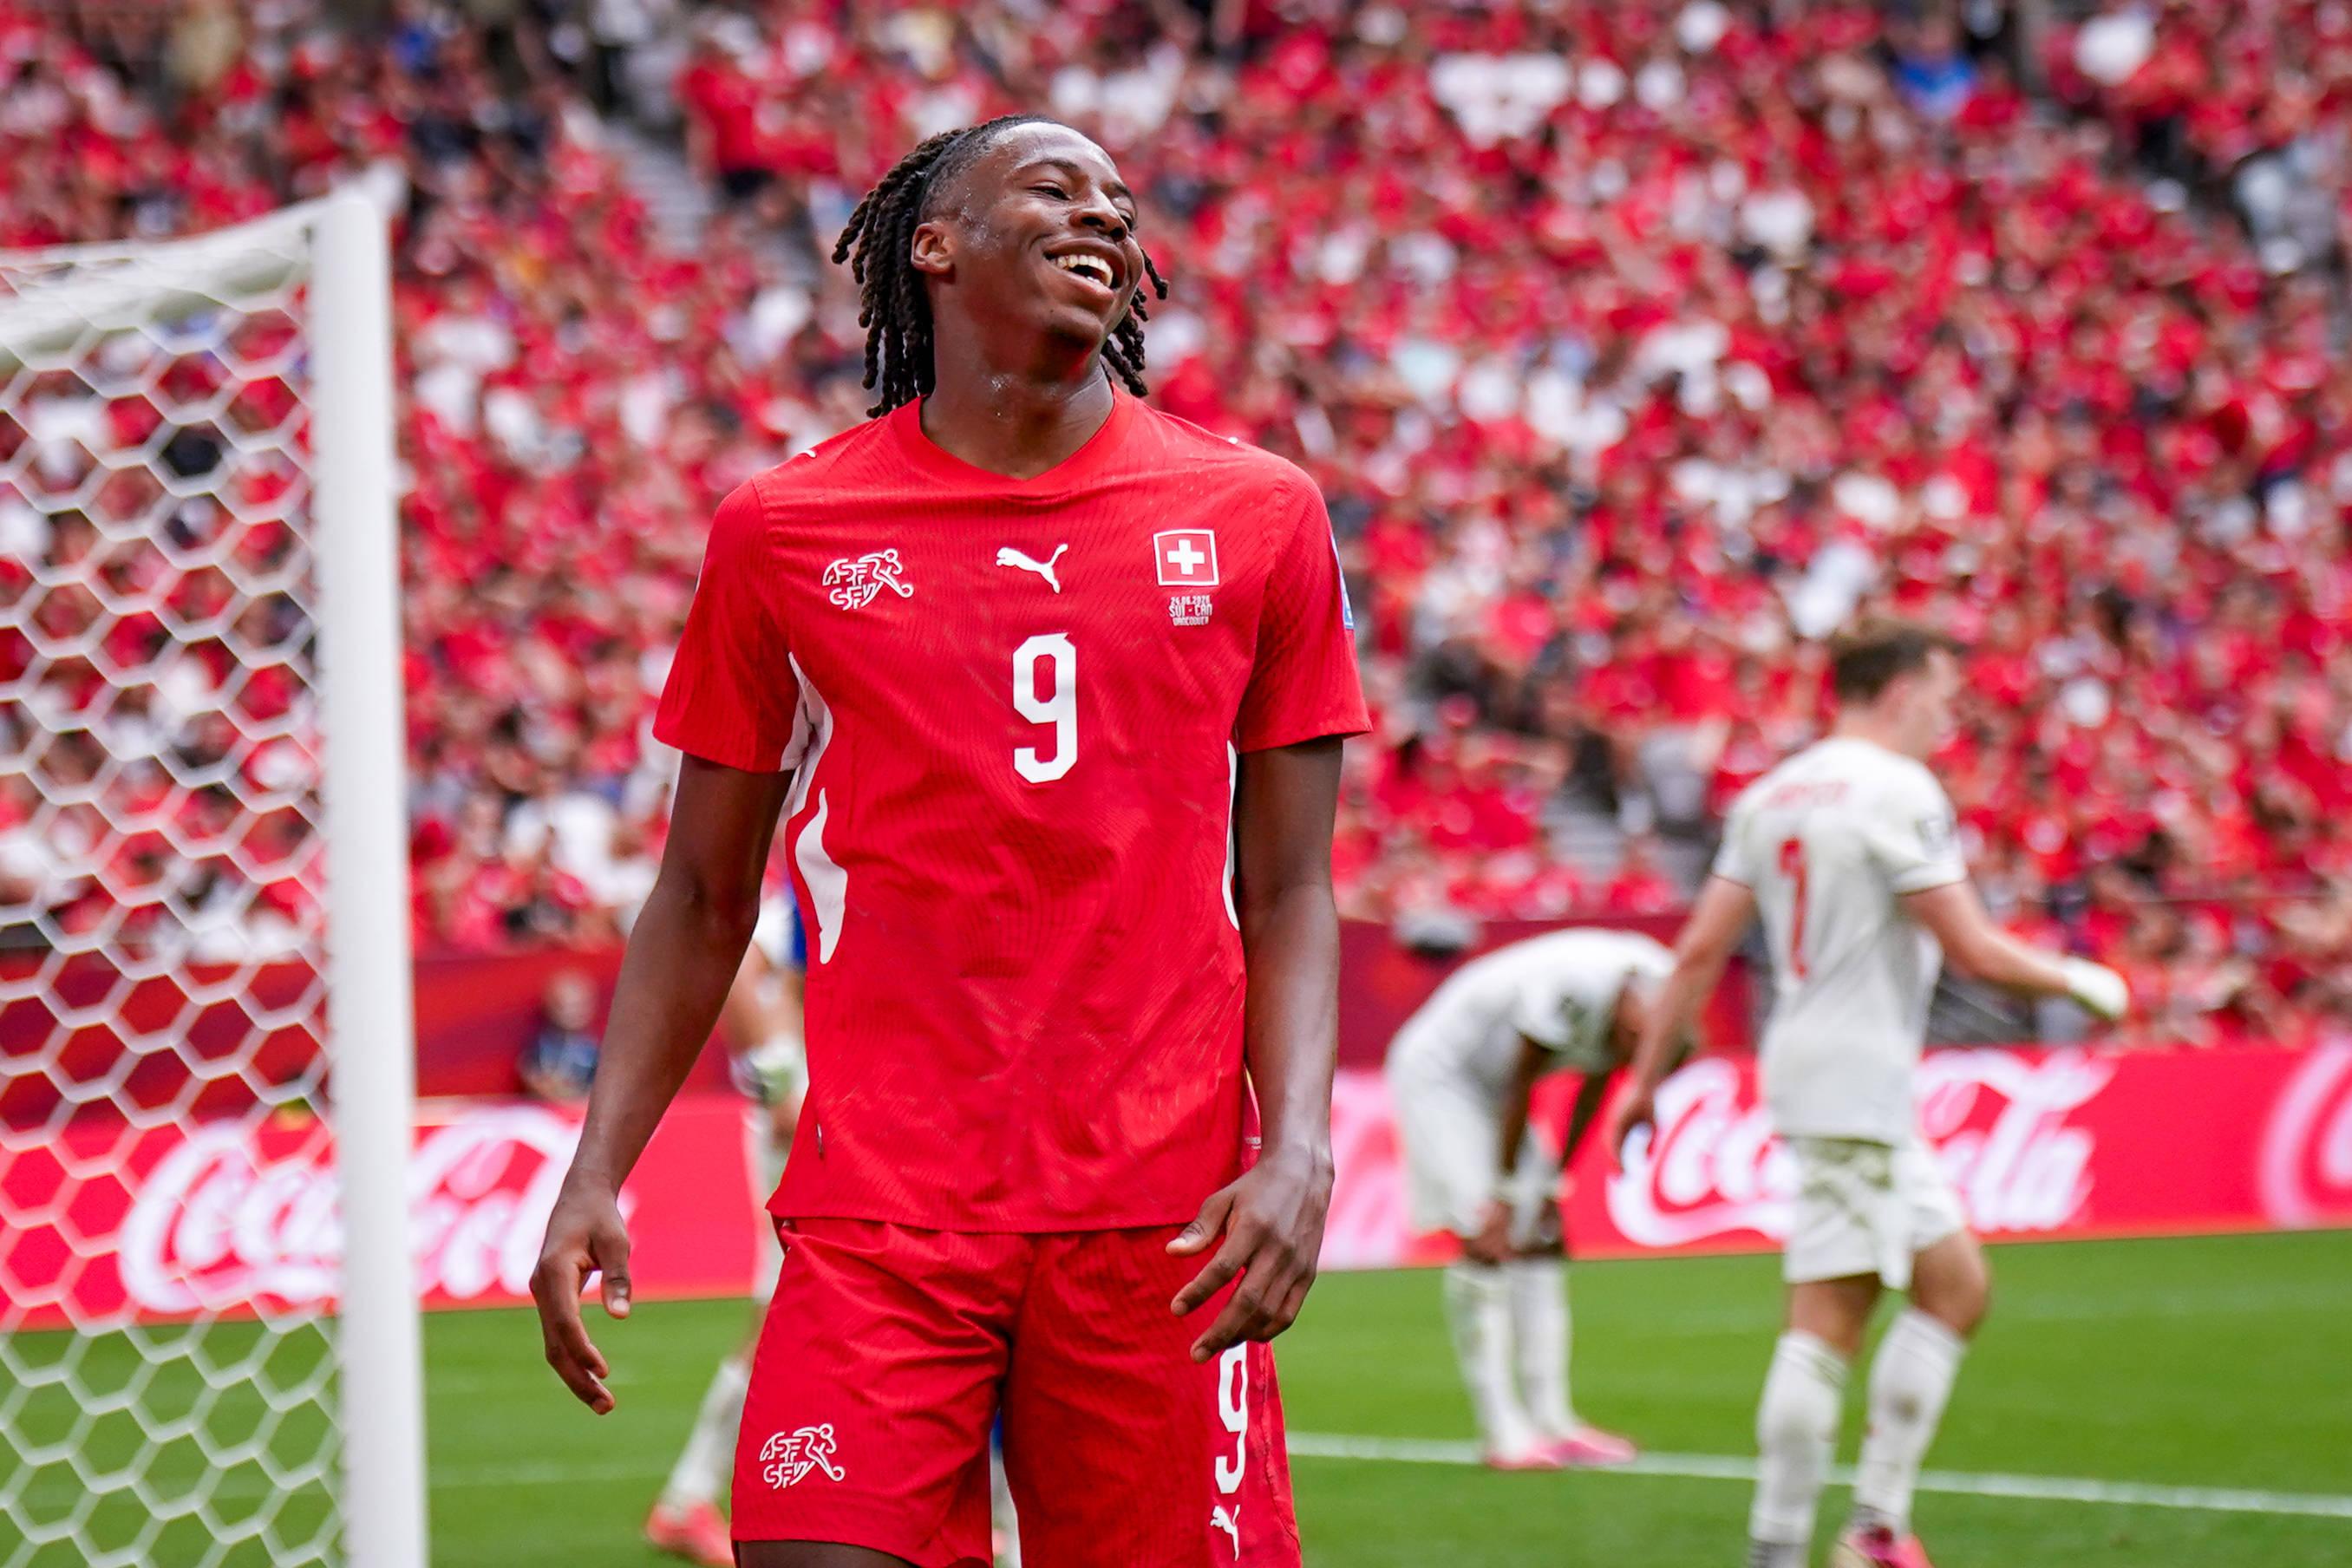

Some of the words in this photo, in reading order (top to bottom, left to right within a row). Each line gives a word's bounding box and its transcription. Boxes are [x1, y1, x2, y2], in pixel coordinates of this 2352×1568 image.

[1169, 604, 1185, 617] SUI
[1194, 604, 1212, 617] CAN
[1013, 632, 1078, 784] 9
[119, 1107, 636, 1311] CocaCol
[1606, 1049, 2119, 1246] Cocola
[1216, 1341, 1248, 1493] 9
